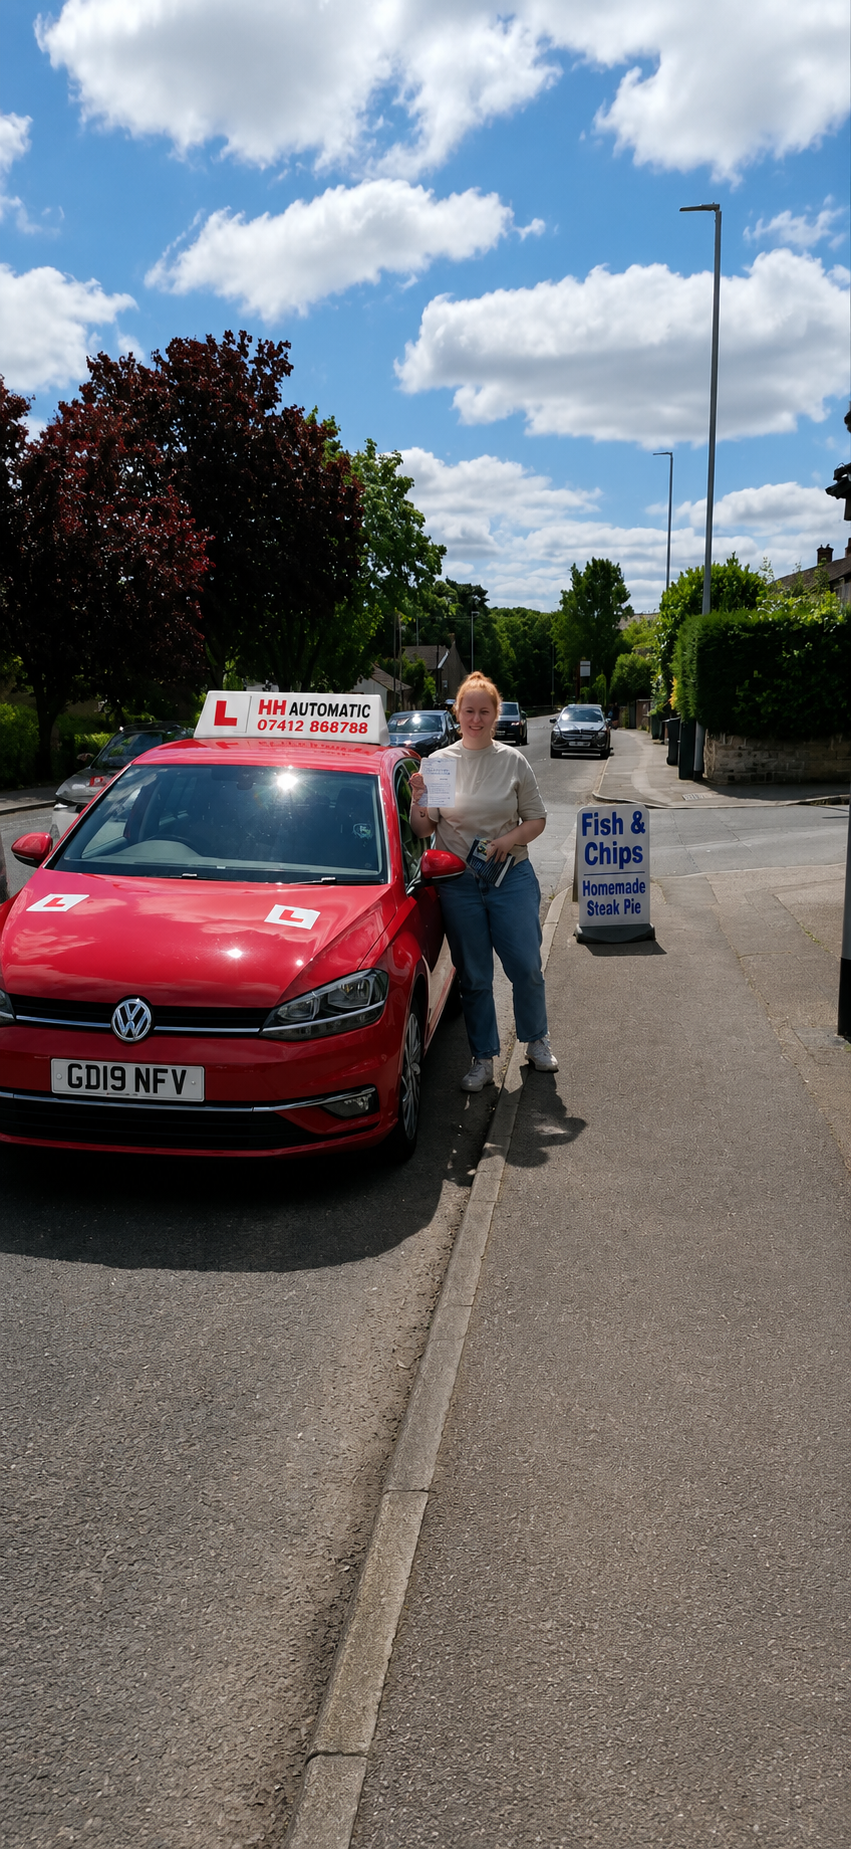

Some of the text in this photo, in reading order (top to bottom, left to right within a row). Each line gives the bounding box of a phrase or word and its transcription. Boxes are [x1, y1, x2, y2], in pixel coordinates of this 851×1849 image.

[213, 700, 238, 727] L
[258, 699, 371, 718] HH AUTOMATIC
[257, 719, 368, 734] 07412 868788
[582, 810, 646, 836] Fish &
[584, 841, 643, 870] Chips
[582, 878, 646, 897] Homemade
[43, 897, 66, 908] L
[587, 898, 641, 916] Steak Pie
[278, 909, 304, 923] L
[67, 1063, 187, 1095] GD19 NFV
